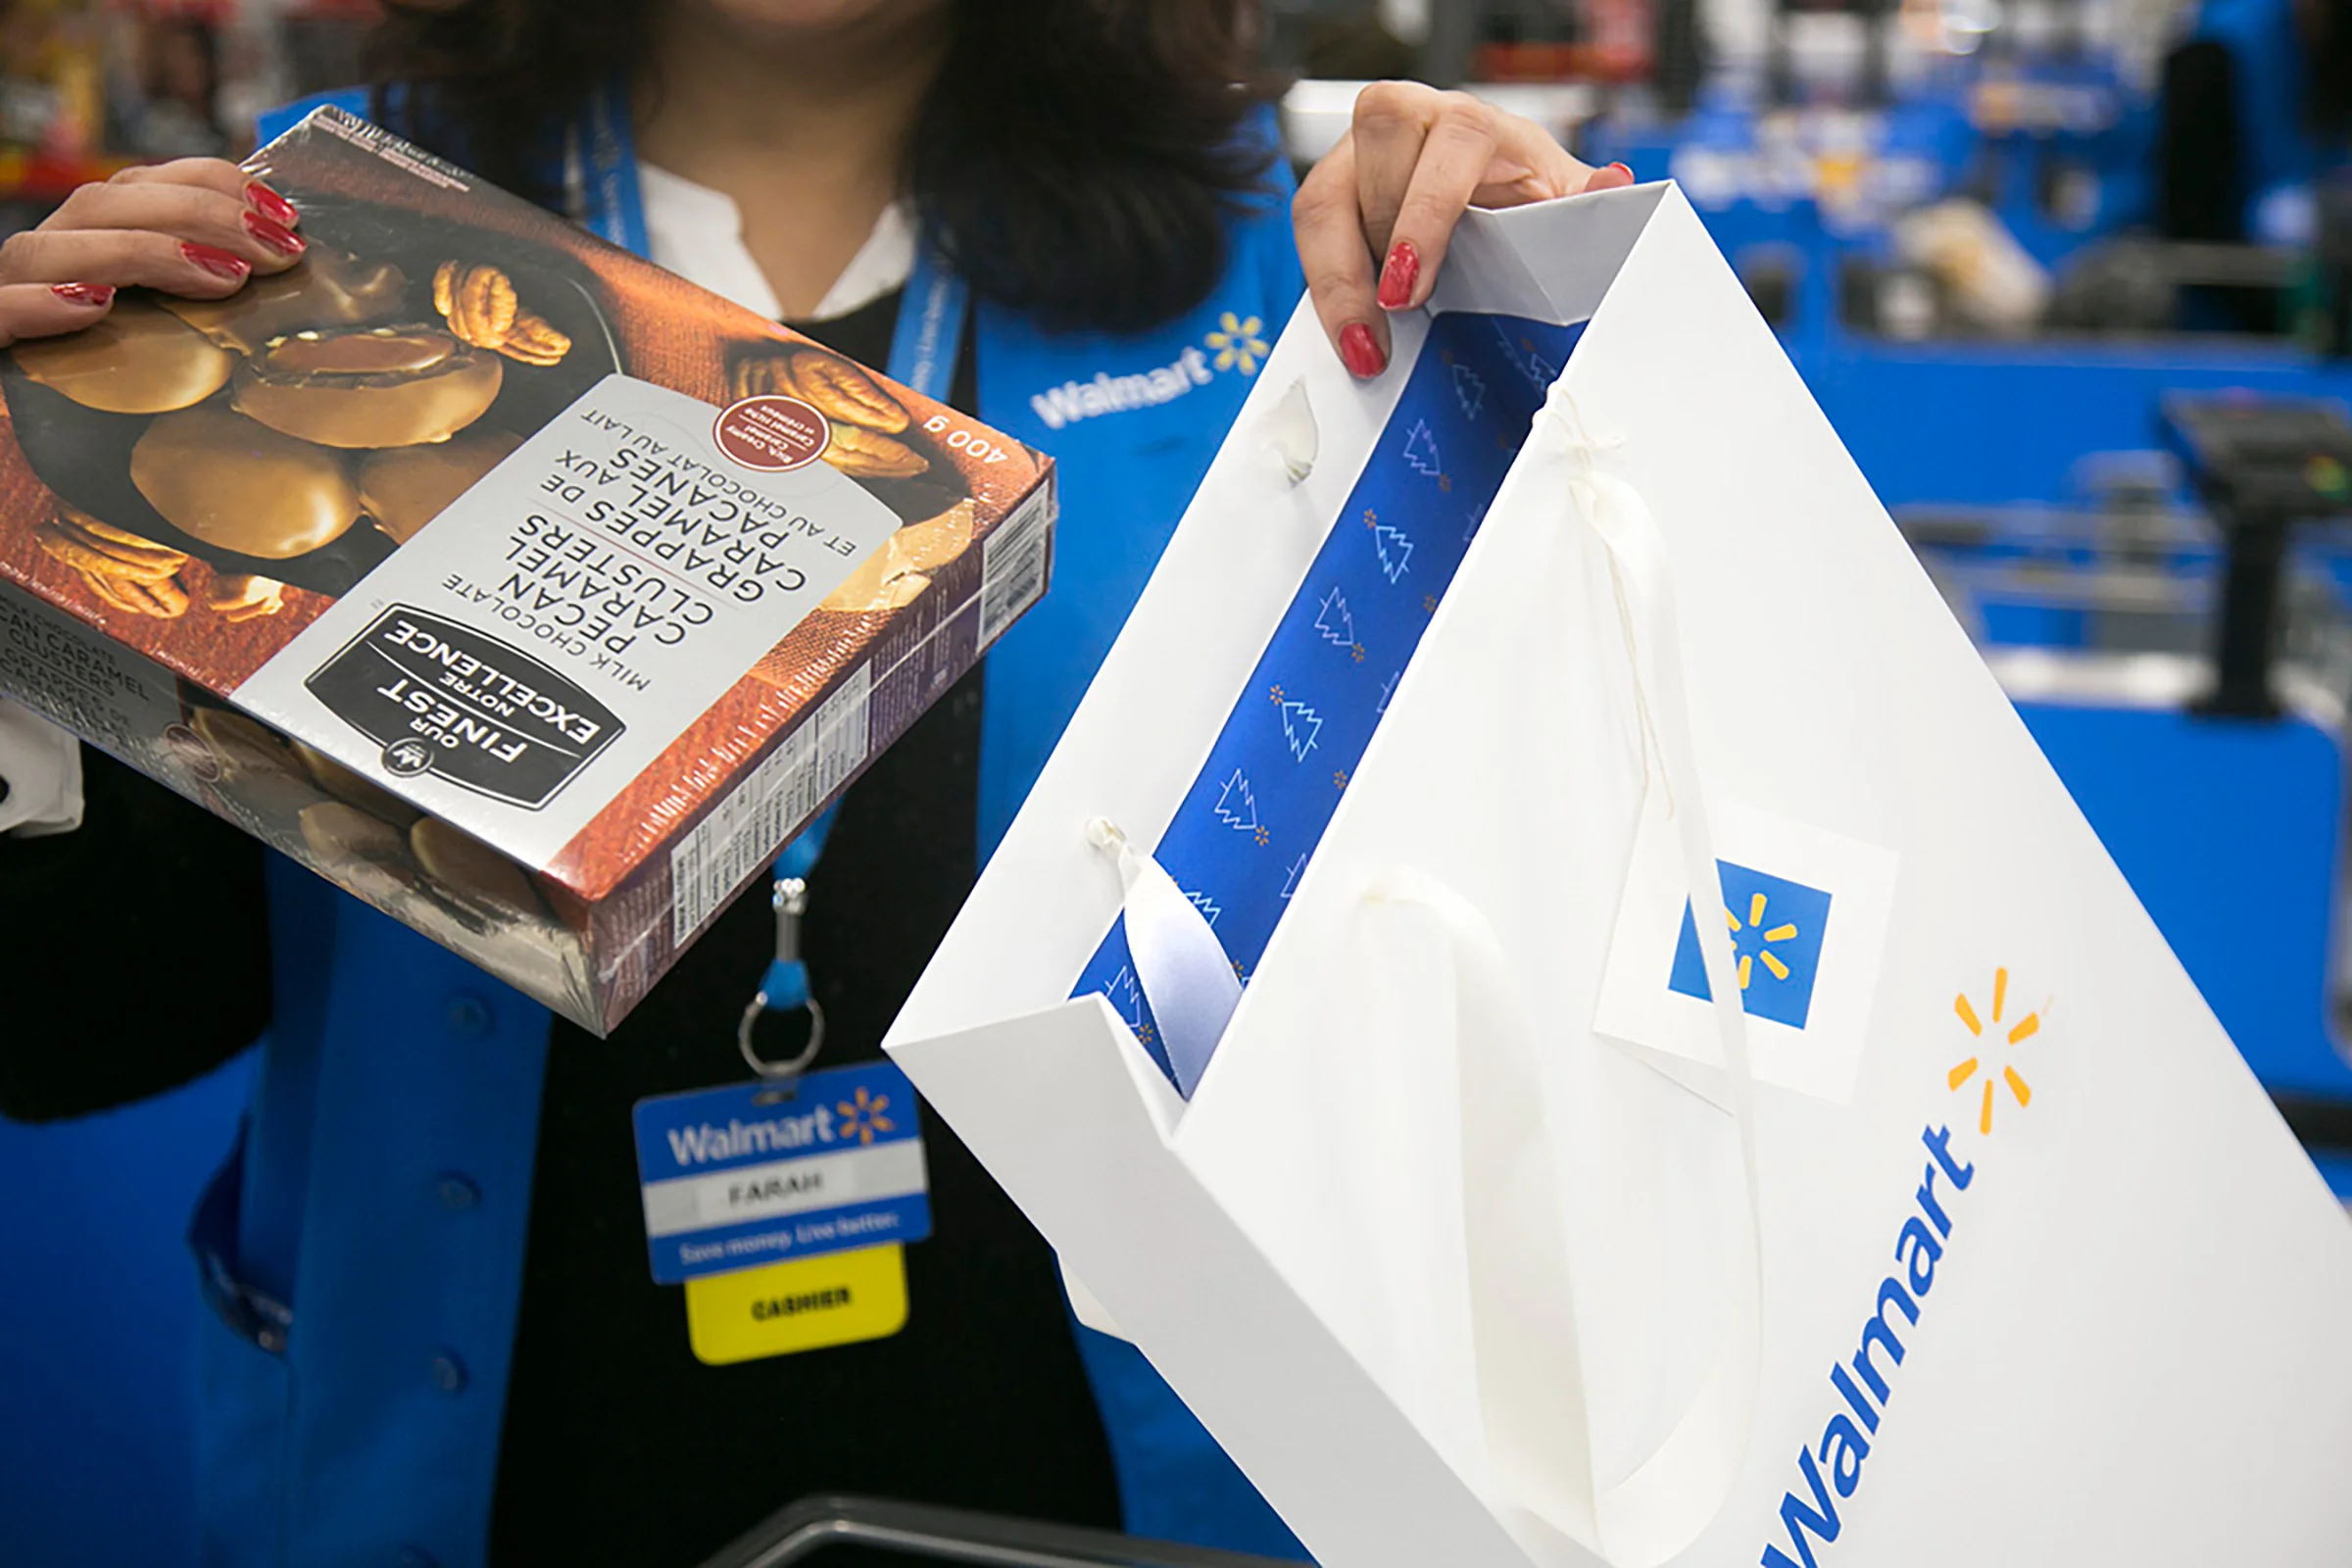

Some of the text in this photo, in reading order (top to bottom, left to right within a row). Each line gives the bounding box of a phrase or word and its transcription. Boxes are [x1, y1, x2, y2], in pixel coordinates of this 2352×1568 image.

[1030, 346, 1213, 429] Walmart
[725, 425, 766, 451] Creamy
[744, 407, 815, 447] Caramel riche
[744, 424, 789, 452] Caramel
[922, 415, 1008, 464] 400 g
[554, 449, 807, 591] CARAMEL AUX
[579, 409, 857, 558] ET AU CHOCOLAT AU LAIT
[608, 447, 790, 550] PACANES
[516, 514, 713, 625] CLUSTERS
[539, 472, 764, 603] GRAPPES DE
[497, 571, 637, 655] PECAN
[505, 534, 686, 645] CARAMEL
[8, 627, 116, 698] CLUSTERS
[48, 632, 150, 702] CARAMEL
[440, 572, 651, 692] MILK CHOCOLATE
[375, 678, 527, 762] FINEST
[382, 618, 601, 745] EXCELLENCE
[437, 670, 515, 717] NOTRE
[409, 716, 460, 749] OUR
[667, 1103, 836, 1166] Walmart
[728, 1172, 823, 1206] FARAH
[678, 1238, 724, 1265] Save
[750, 1286, 853, 1322] CASHIER
[1759, 1123, 1976, 1568] Walmart
